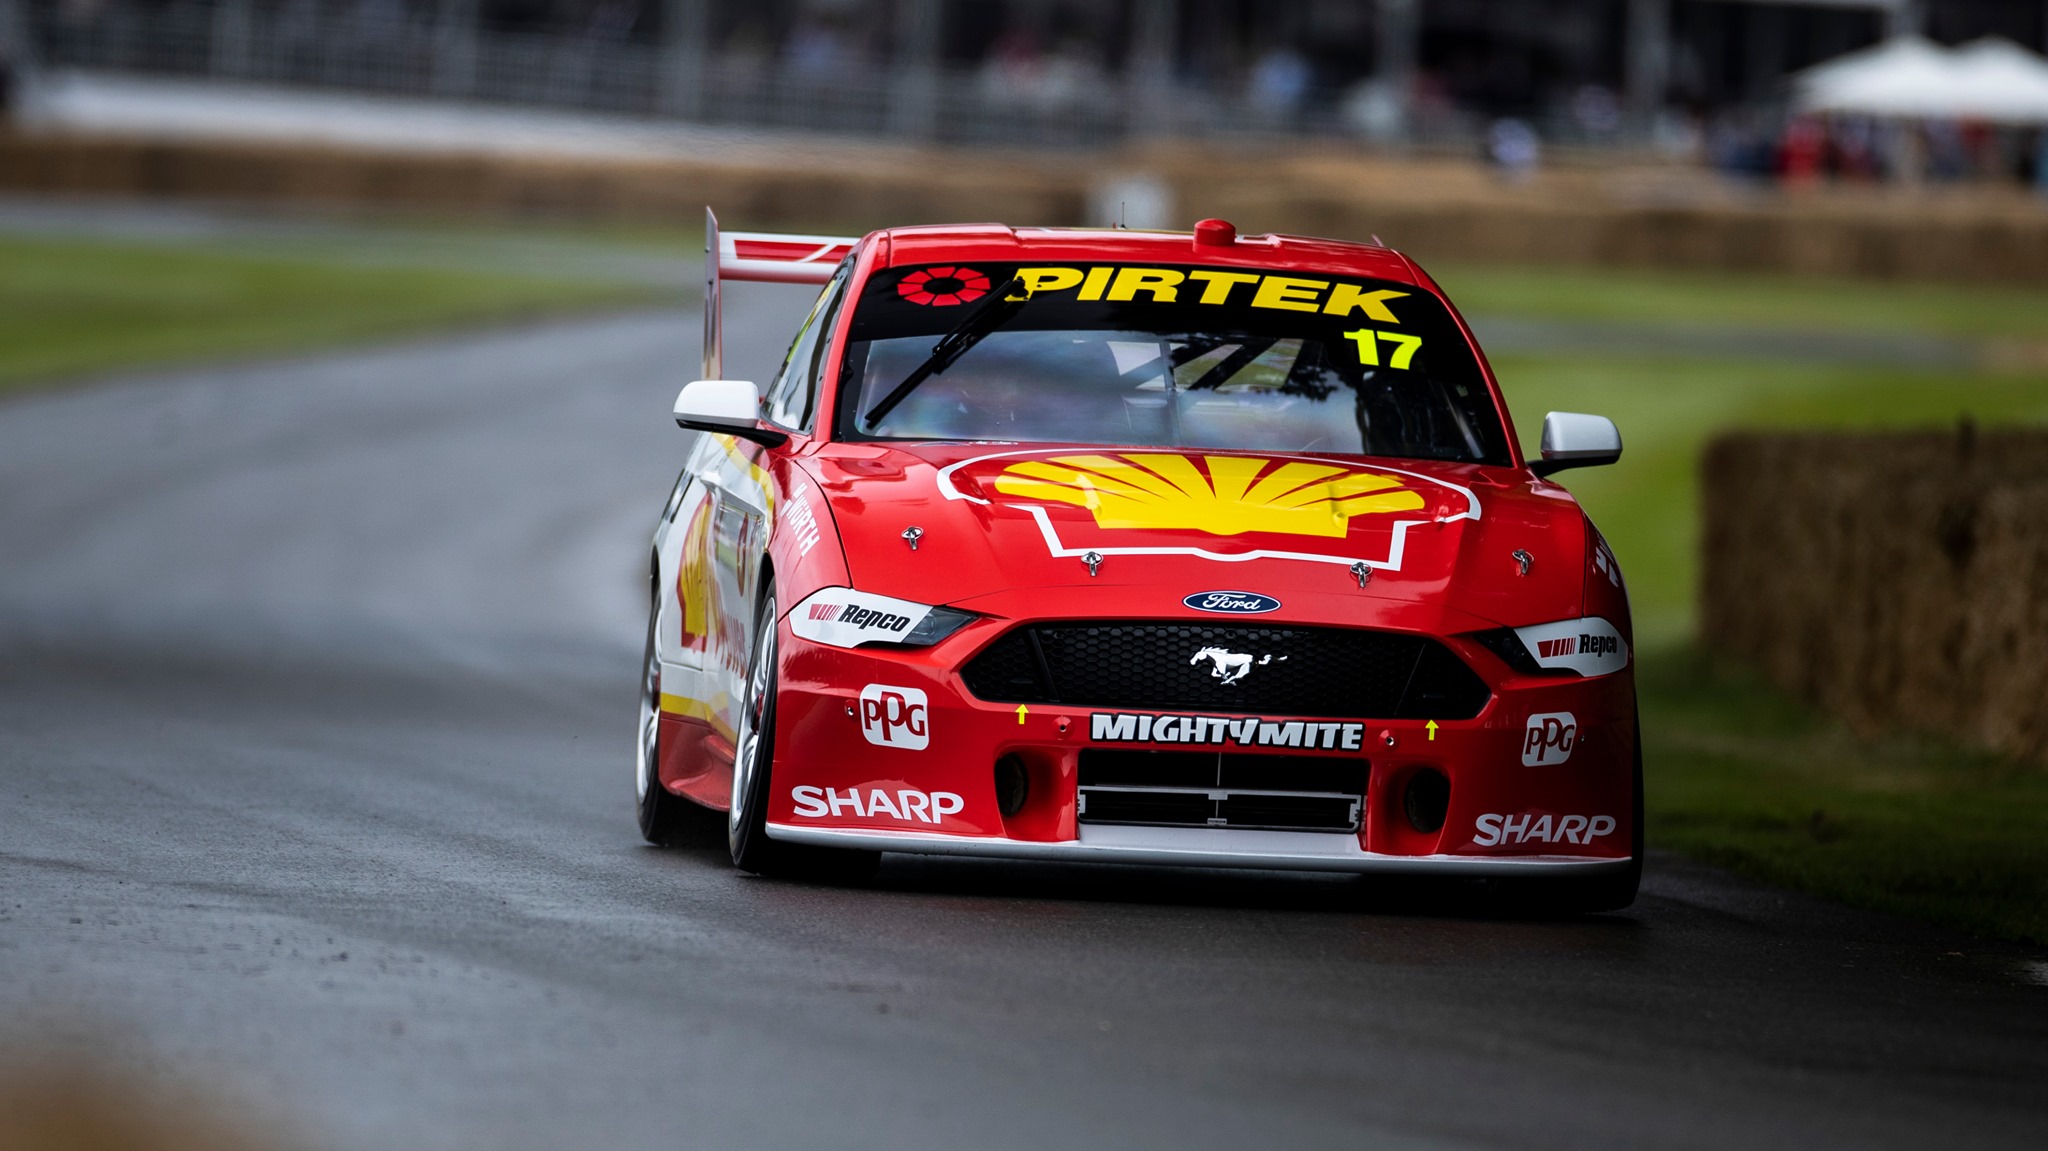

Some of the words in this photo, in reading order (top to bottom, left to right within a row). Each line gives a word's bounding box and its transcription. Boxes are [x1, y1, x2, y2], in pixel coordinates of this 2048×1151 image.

[1005, 267, 1411, 324] PIRTEK
[1344, 328, 1423, 370] 17
[838, 604, 911, 632] Repco
[1202, 593, 1262, 610] Ford
[1579, 634, 1617, 657] Repco
[863, 691, 926, 742] PPG
[1525, 718, 1575, 762] PPG
[792, 785, 965, 825] SHARP
[1473, 813, 1615, 847] SHARP
